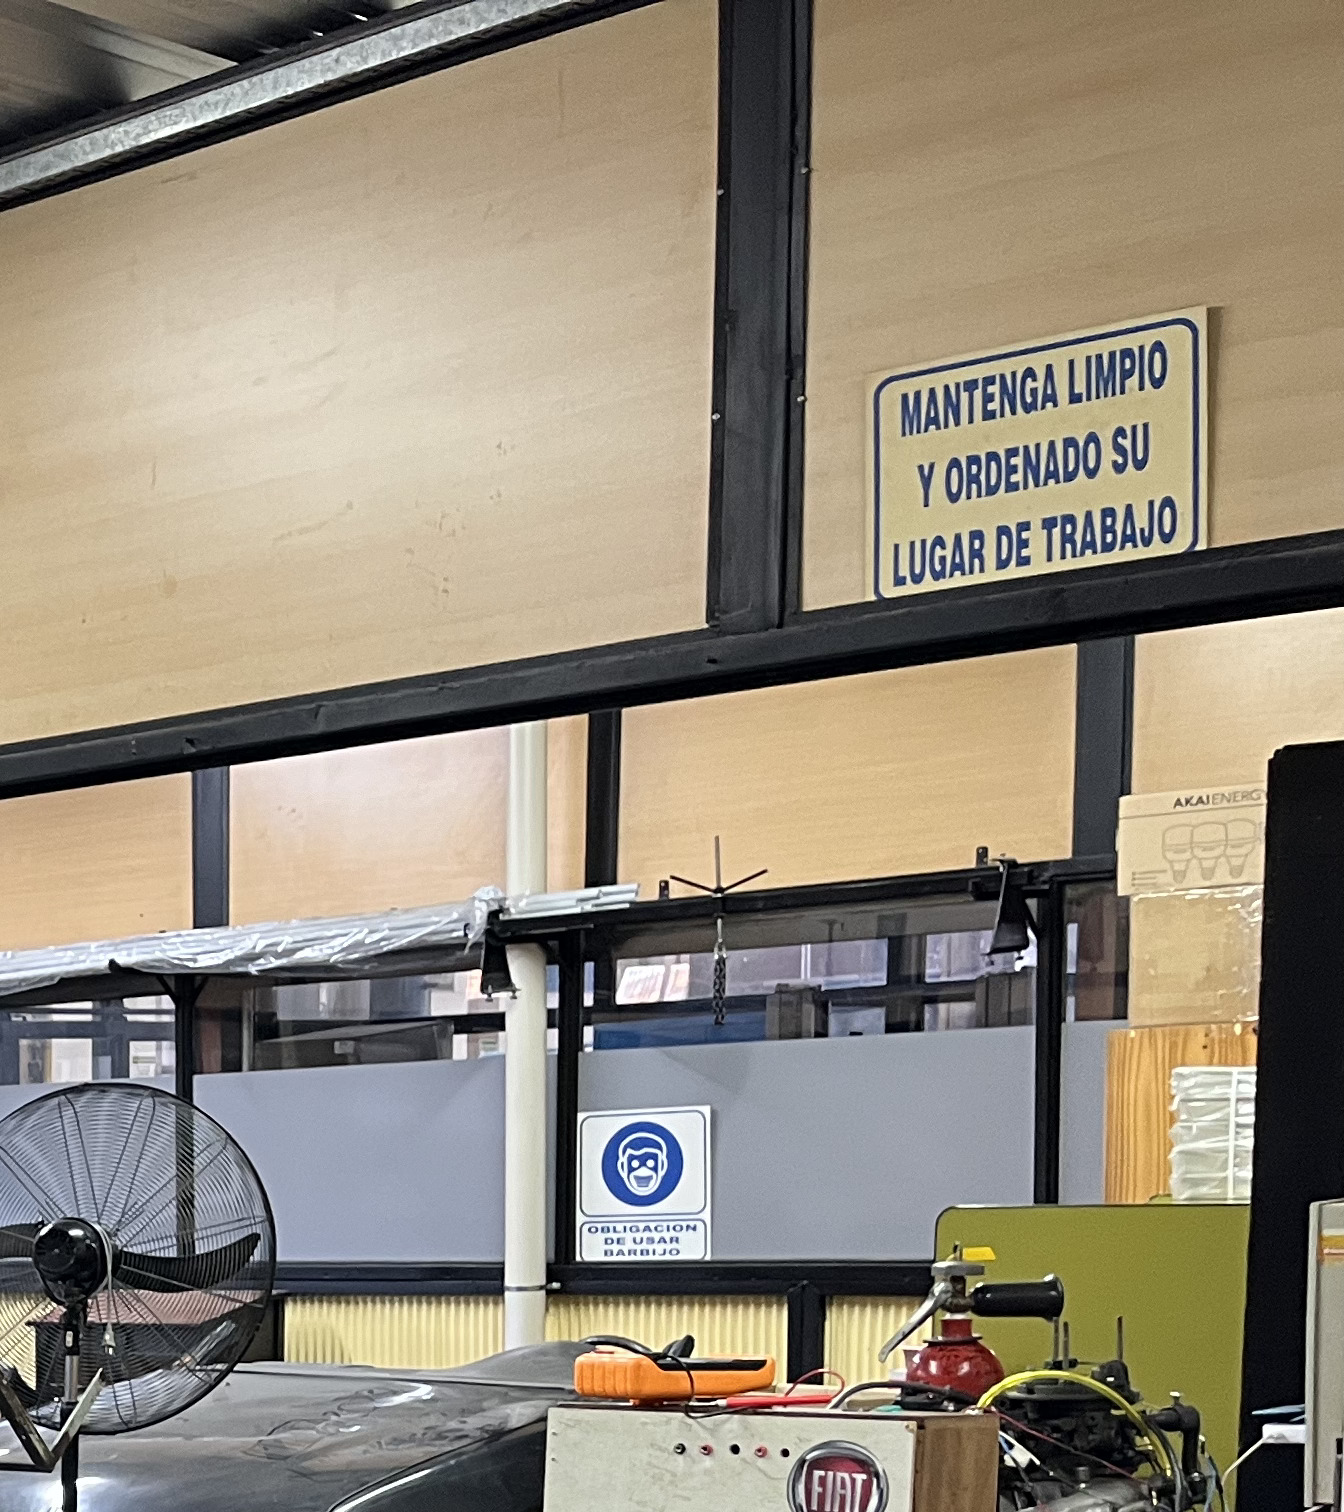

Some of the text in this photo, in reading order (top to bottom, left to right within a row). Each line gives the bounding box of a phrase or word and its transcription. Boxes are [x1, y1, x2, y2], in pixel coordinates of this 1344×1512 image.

[901, 340, 1168, 437] MANTENGA LIMPIO
[918, 422, 1150, 507] Y ORDENADO SU
[893, 496, 1177, 587] LUGAR DE TRABAJO
[1173, 788, 1265, 808] AKAIENERG
[587, 1224, 697, 1234] OBLIGACION
[604, 1236, 680, 1246] DE USAR
[604, 1248, 681, 1257] BARBIJO
